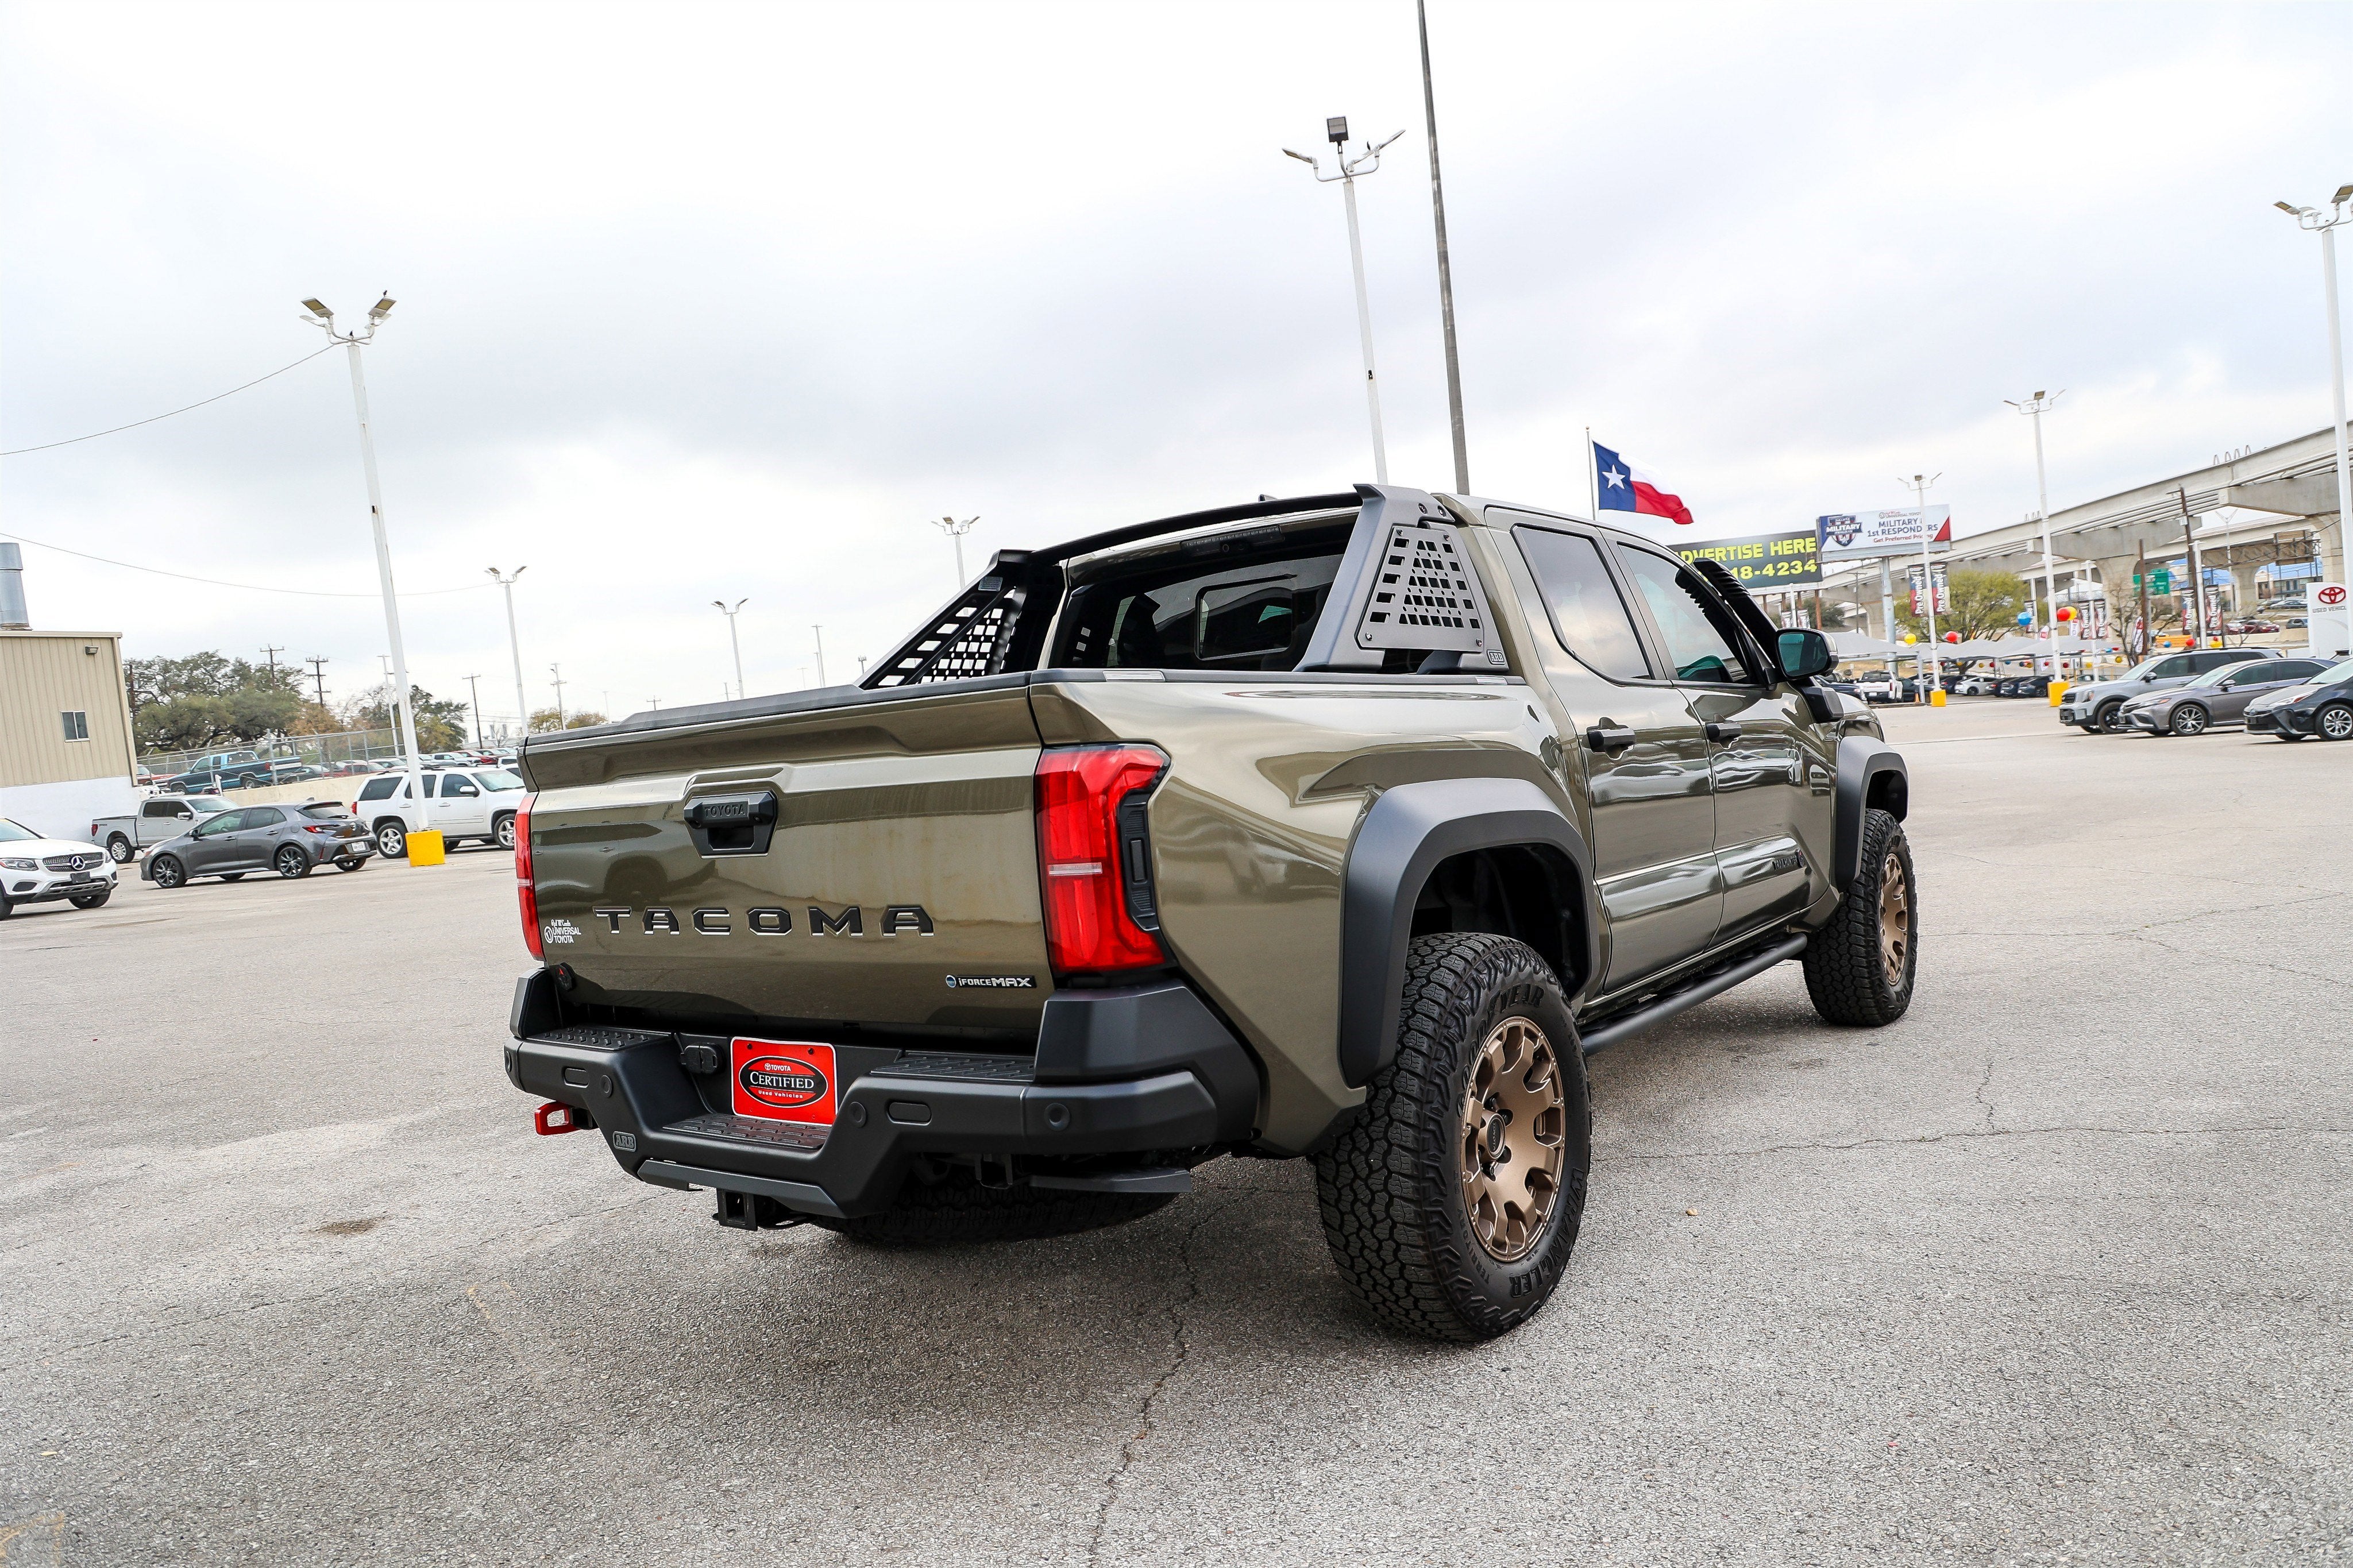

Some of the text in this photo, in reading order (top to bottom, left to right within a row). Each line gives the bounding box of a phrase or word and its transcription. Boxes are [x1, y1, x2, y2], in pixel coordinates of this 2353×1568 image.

[1826, 523, 1861, 532] MILITARY
[1878, 517, 1918, 528] MILITARY
[1881, 524, 1939, 535] RESPONDRS
[1675, 537, 1817, 565] DVERTISE HERE
[1914, 576, 1923, 601] Owned
[1935, 573, 1945, 600] Owned
[1915, 601, 1924, 615] Pre
[1936, 599, 1946, 612] Pre
[704, 804, 746, 818] TOYOTA
[592, 906, 934, 937] TACOMA
[552, 926, 582, 935] UNIVERSAL
[554, 935, 574, 943] TOYOTA
[750, 1071, 815, 1088] CERTIFIED
[616, 1134, 634, 1148] ARB
[1509, 1167, 1585, 1299] WRANGLER
